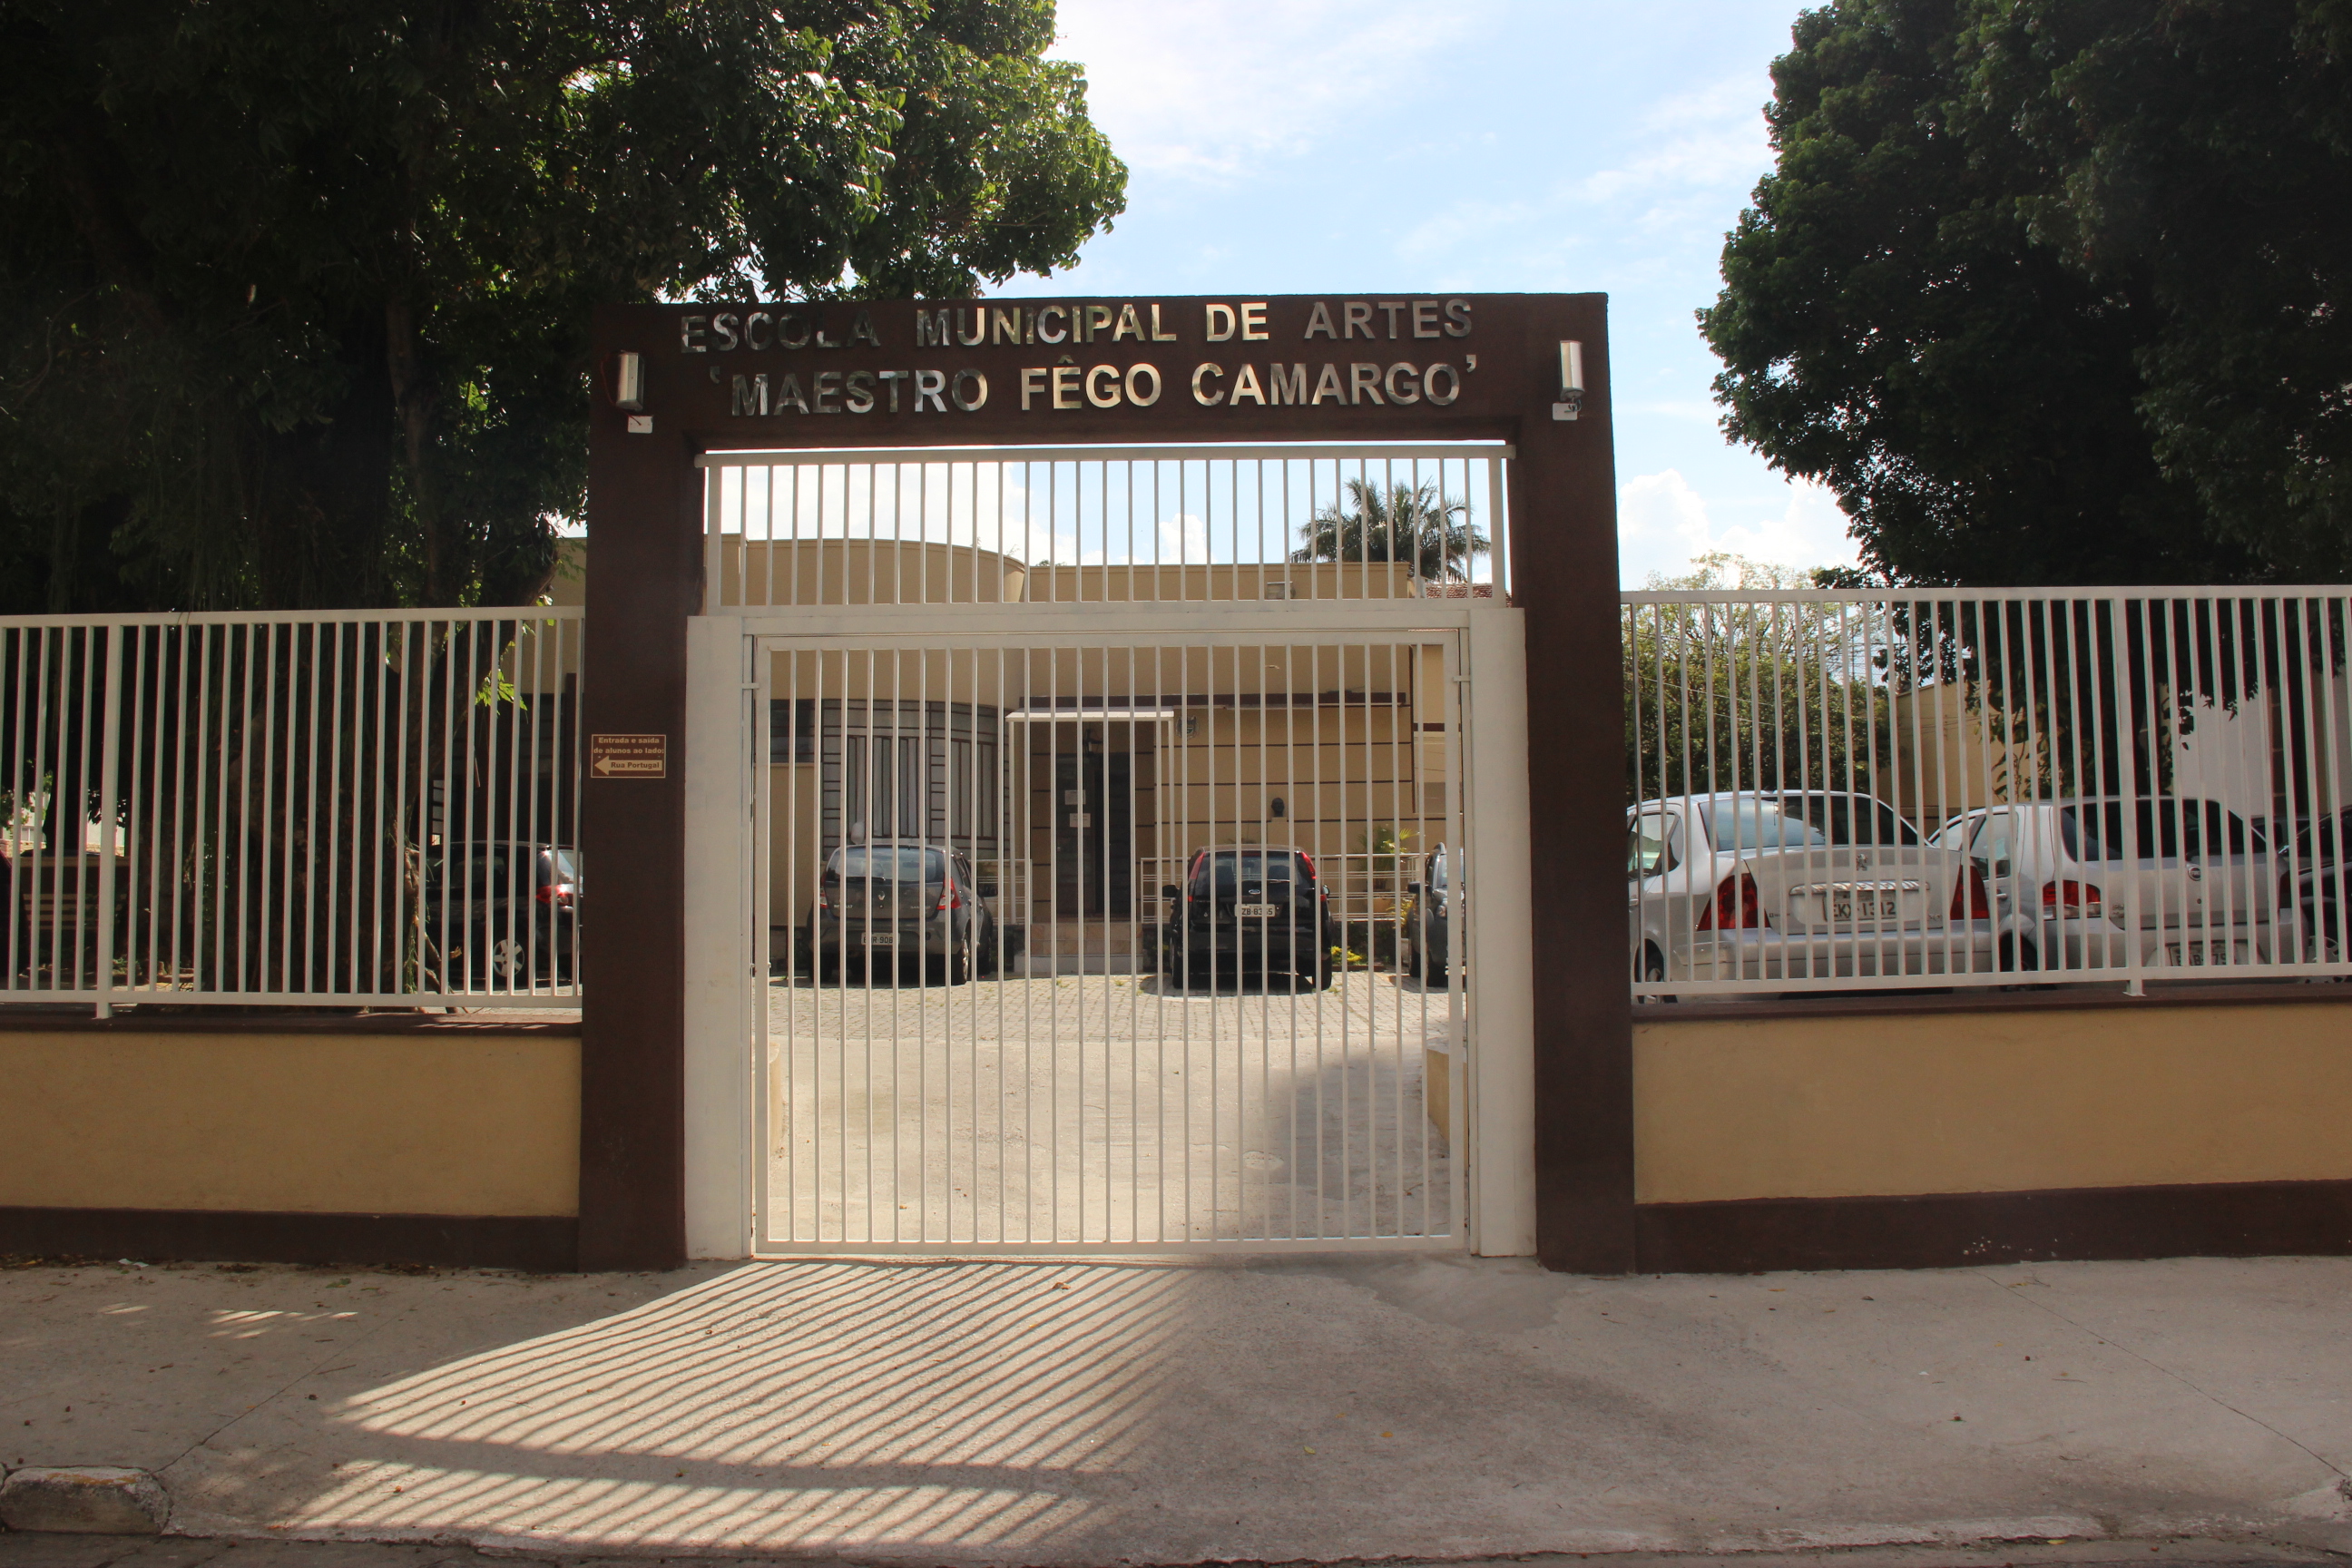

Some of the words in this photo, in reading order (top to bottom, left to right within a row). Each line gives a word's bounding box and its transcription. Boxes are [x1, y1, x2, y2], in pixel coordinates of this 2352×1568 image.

[681, 309, 881, 353] ESCOLA
[916, 303, 1177, 348] MUNICIPAL
[1205, 302, 1269, 342] DE
[1304, 299, 1473, 340] ARTES
[1020, 354, 1162, 411] FÊGO
[627, 761, 660, 769] Portugal
